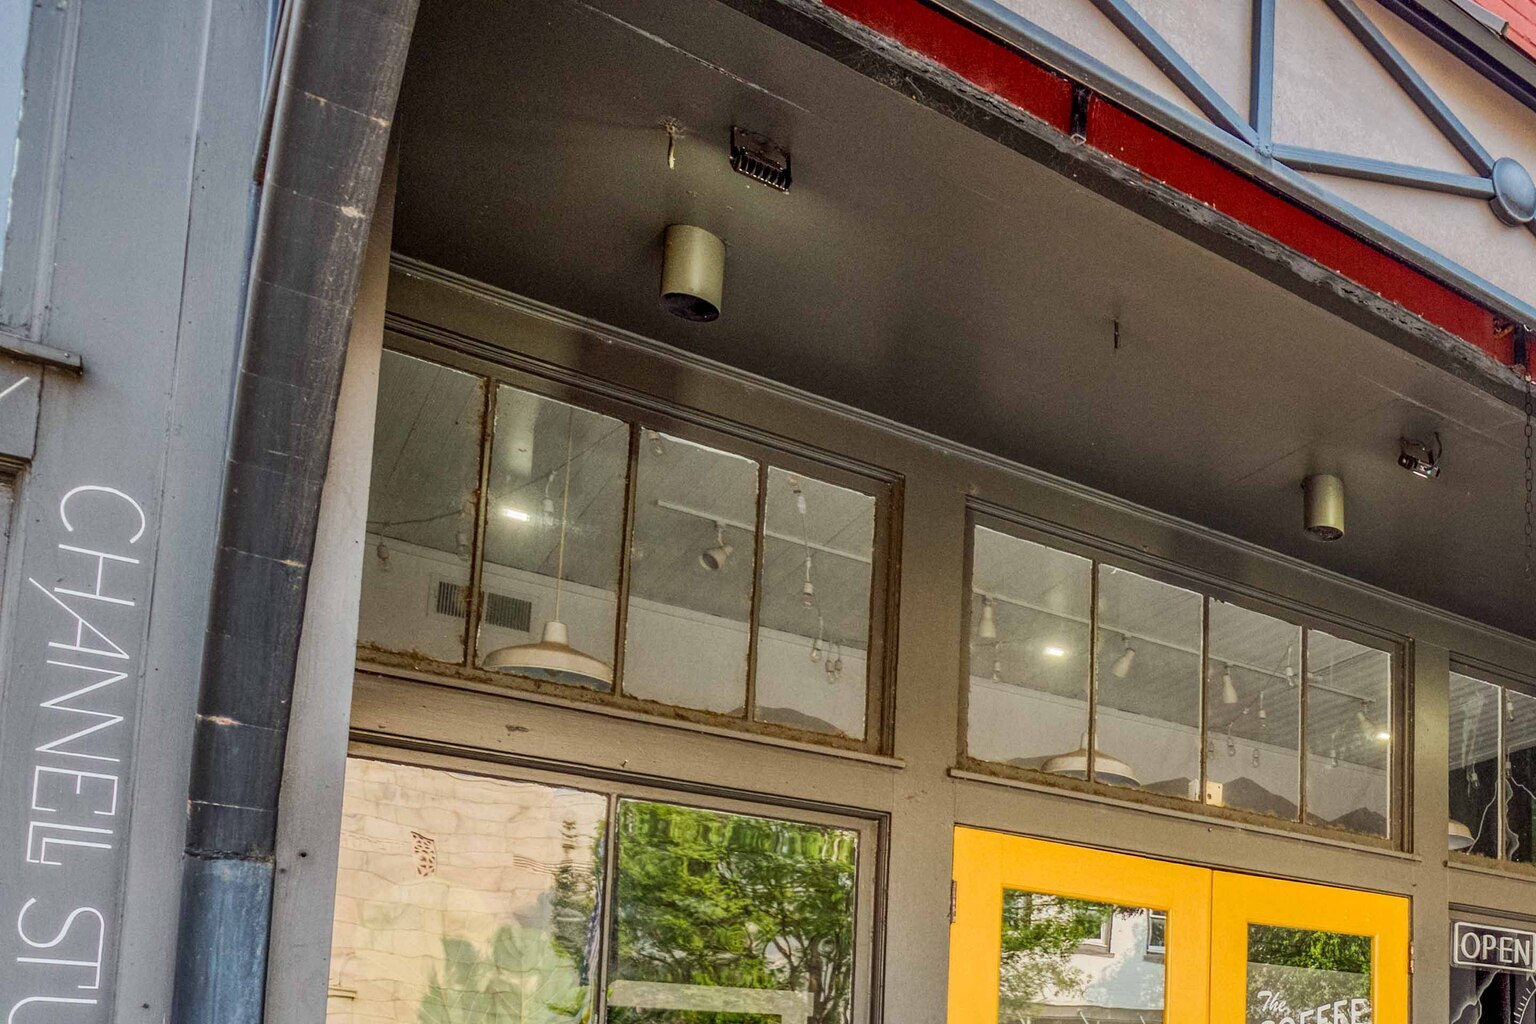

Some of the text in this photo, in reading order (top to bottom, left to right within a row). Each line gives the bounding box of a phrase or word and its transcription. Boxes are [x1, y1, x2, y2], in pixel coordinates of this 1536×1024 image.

[25, 485, 146, 867] CHANNEL
[1460, 932, 1531, 966] OPEN
[1257, 990, 1287, 1012] The
